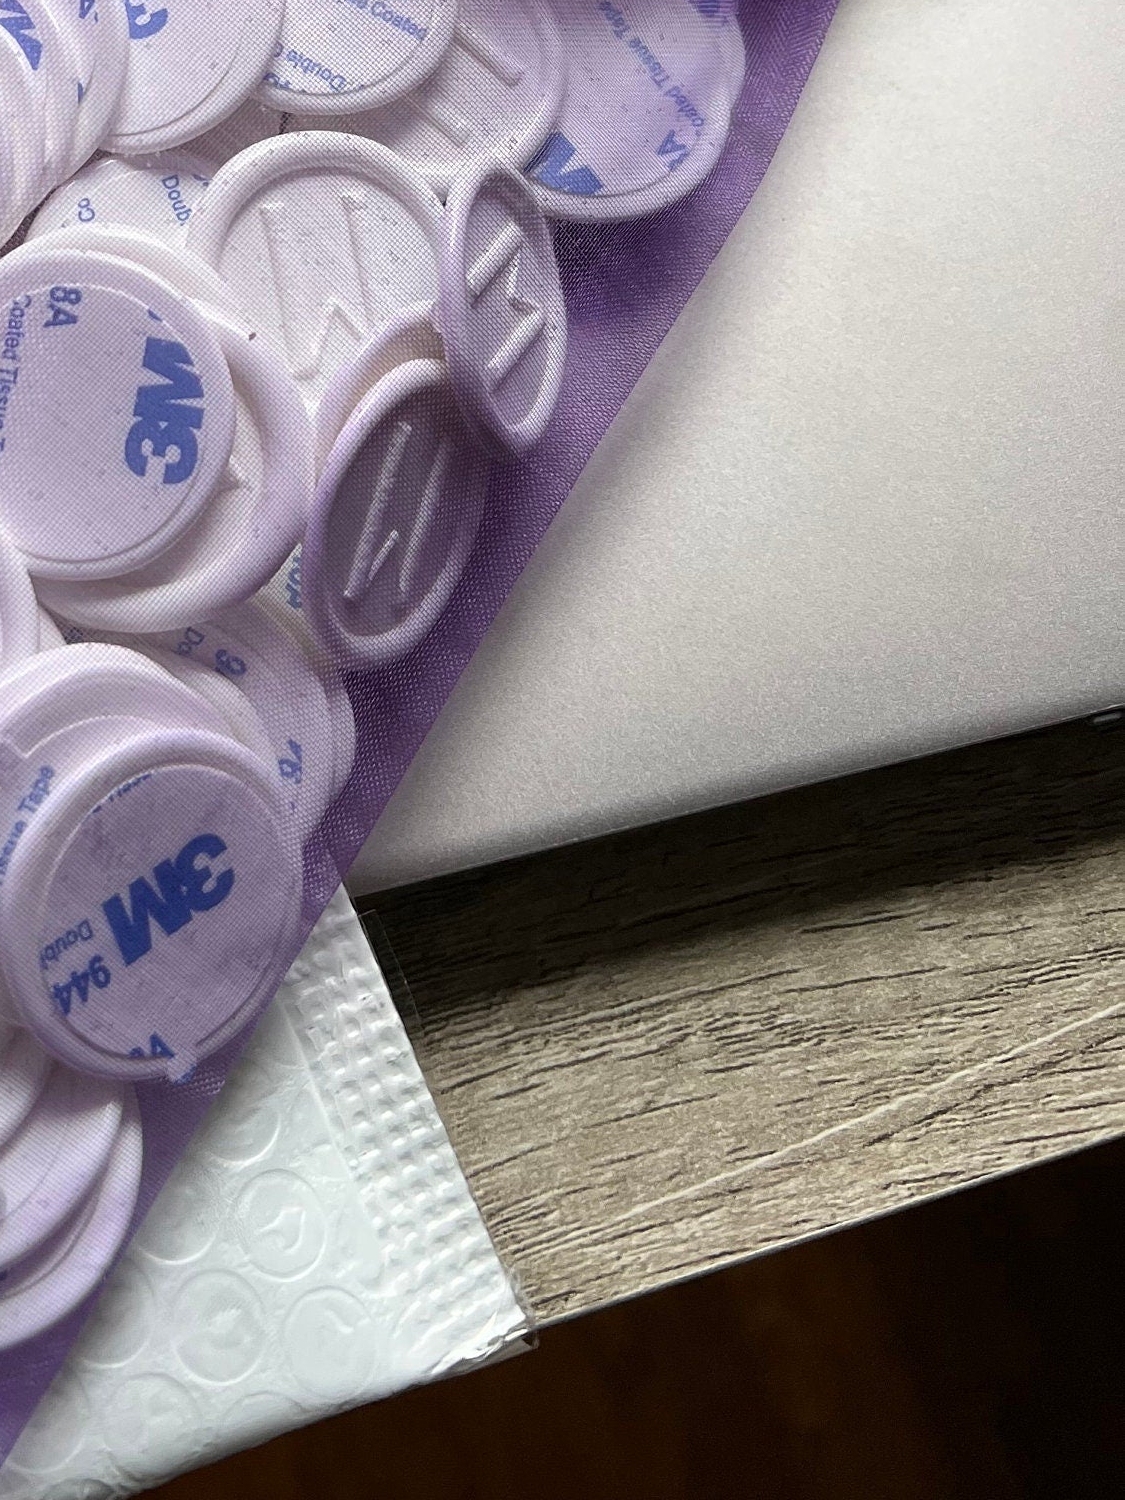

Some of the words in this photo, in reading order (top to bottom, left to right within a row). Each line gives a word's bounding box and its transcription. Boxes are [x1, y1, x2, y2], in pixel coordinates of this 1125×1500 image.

[371, 0, 428, 44] Coated
[124, 335, 206, 485] 3M
[17, 765, 55, 814] Tape
[101, 833, 236, 968] 3M
